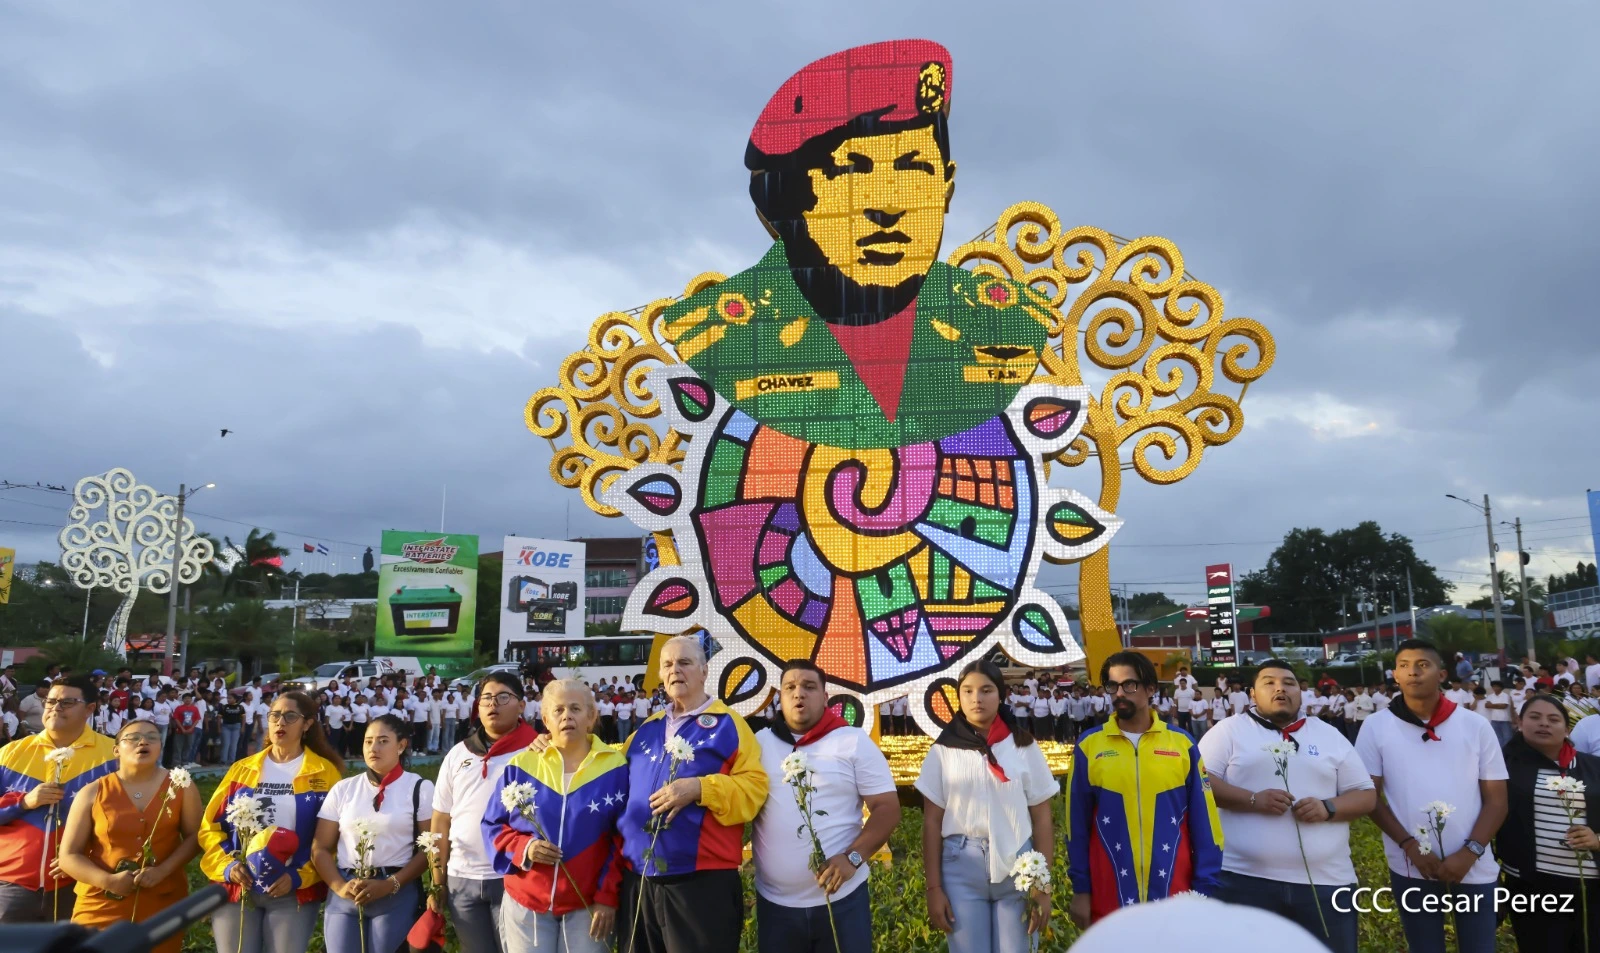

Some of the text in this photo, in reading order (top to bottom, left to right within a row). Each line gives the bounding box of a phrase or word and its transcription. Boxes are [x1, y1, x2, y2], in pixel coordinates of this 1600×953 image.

[988, 370, 1020, 380] F.A.N.
[758, 377, 814, 391] CHAVEZ
[403, 544, 456, 553] INTERSTATE
[404, 552, 452, 560] BATTERIES
[517, 550, 573, 568] KOBE
[393, 565, 464, 575] Excesivamente Confiables
[525, 588, 539, 596] KOBE
[533, 612, 553, 620] KOBE
